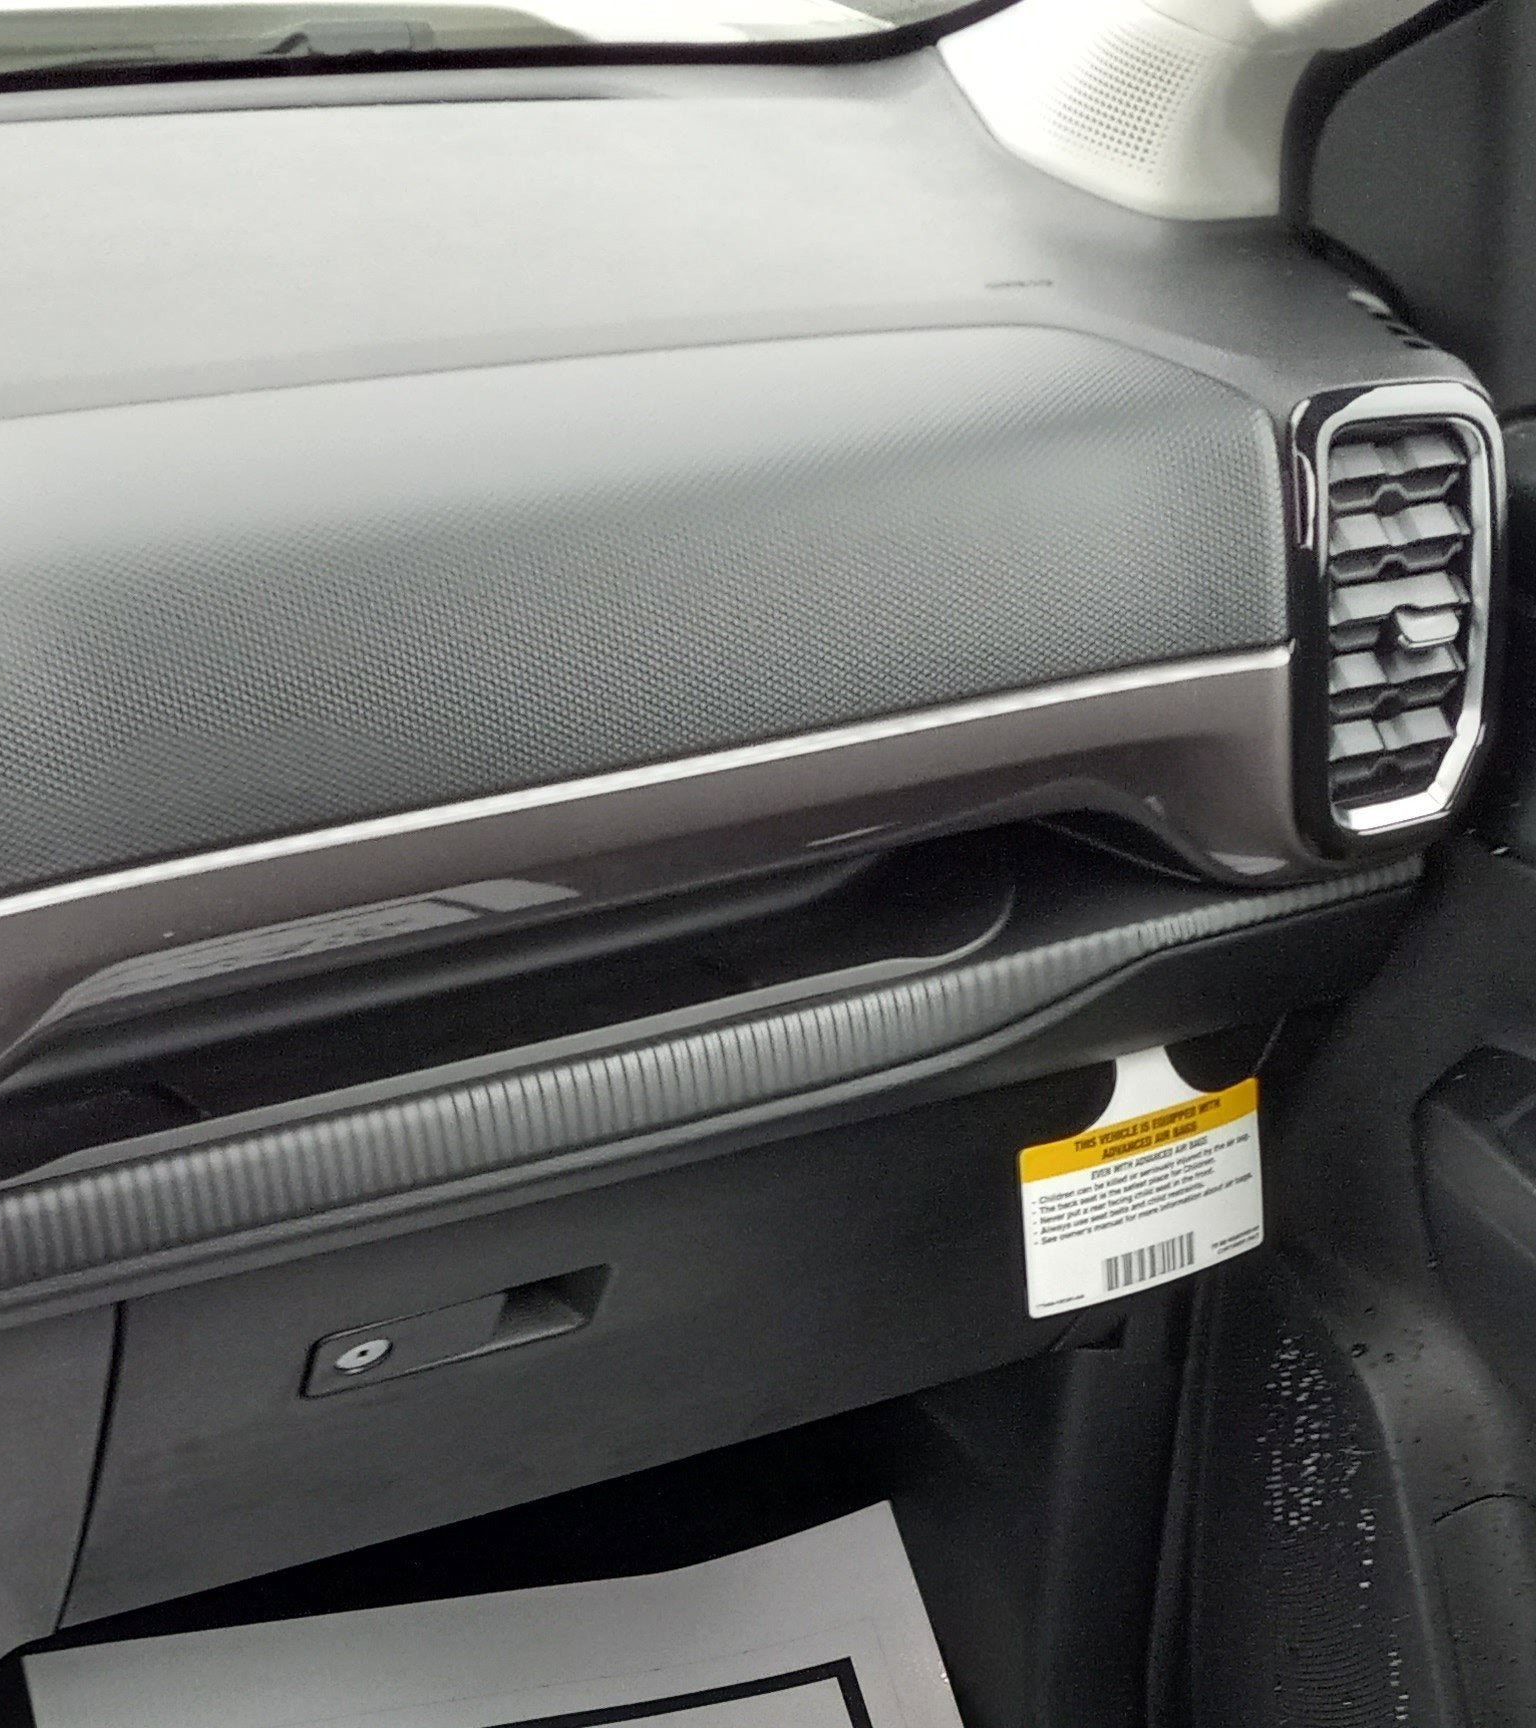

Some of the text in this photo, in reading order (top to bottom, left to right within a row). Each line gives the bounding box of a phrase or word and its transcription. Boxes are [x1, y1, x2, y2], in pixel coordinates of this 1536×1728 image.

[1074, 1137, 1096, 1152] THIS
[1099, 1124, 1138, 1144] VEHICLE
[1152, 1106, 1196, 1129] EQUIPPED
[1199, 1098, 1220, 1114] WITH
[1102, 1121, 1197, 1160] ADVANCED AIR BAGS
[1135, 1148, 1173, 1167] ADVANCED
